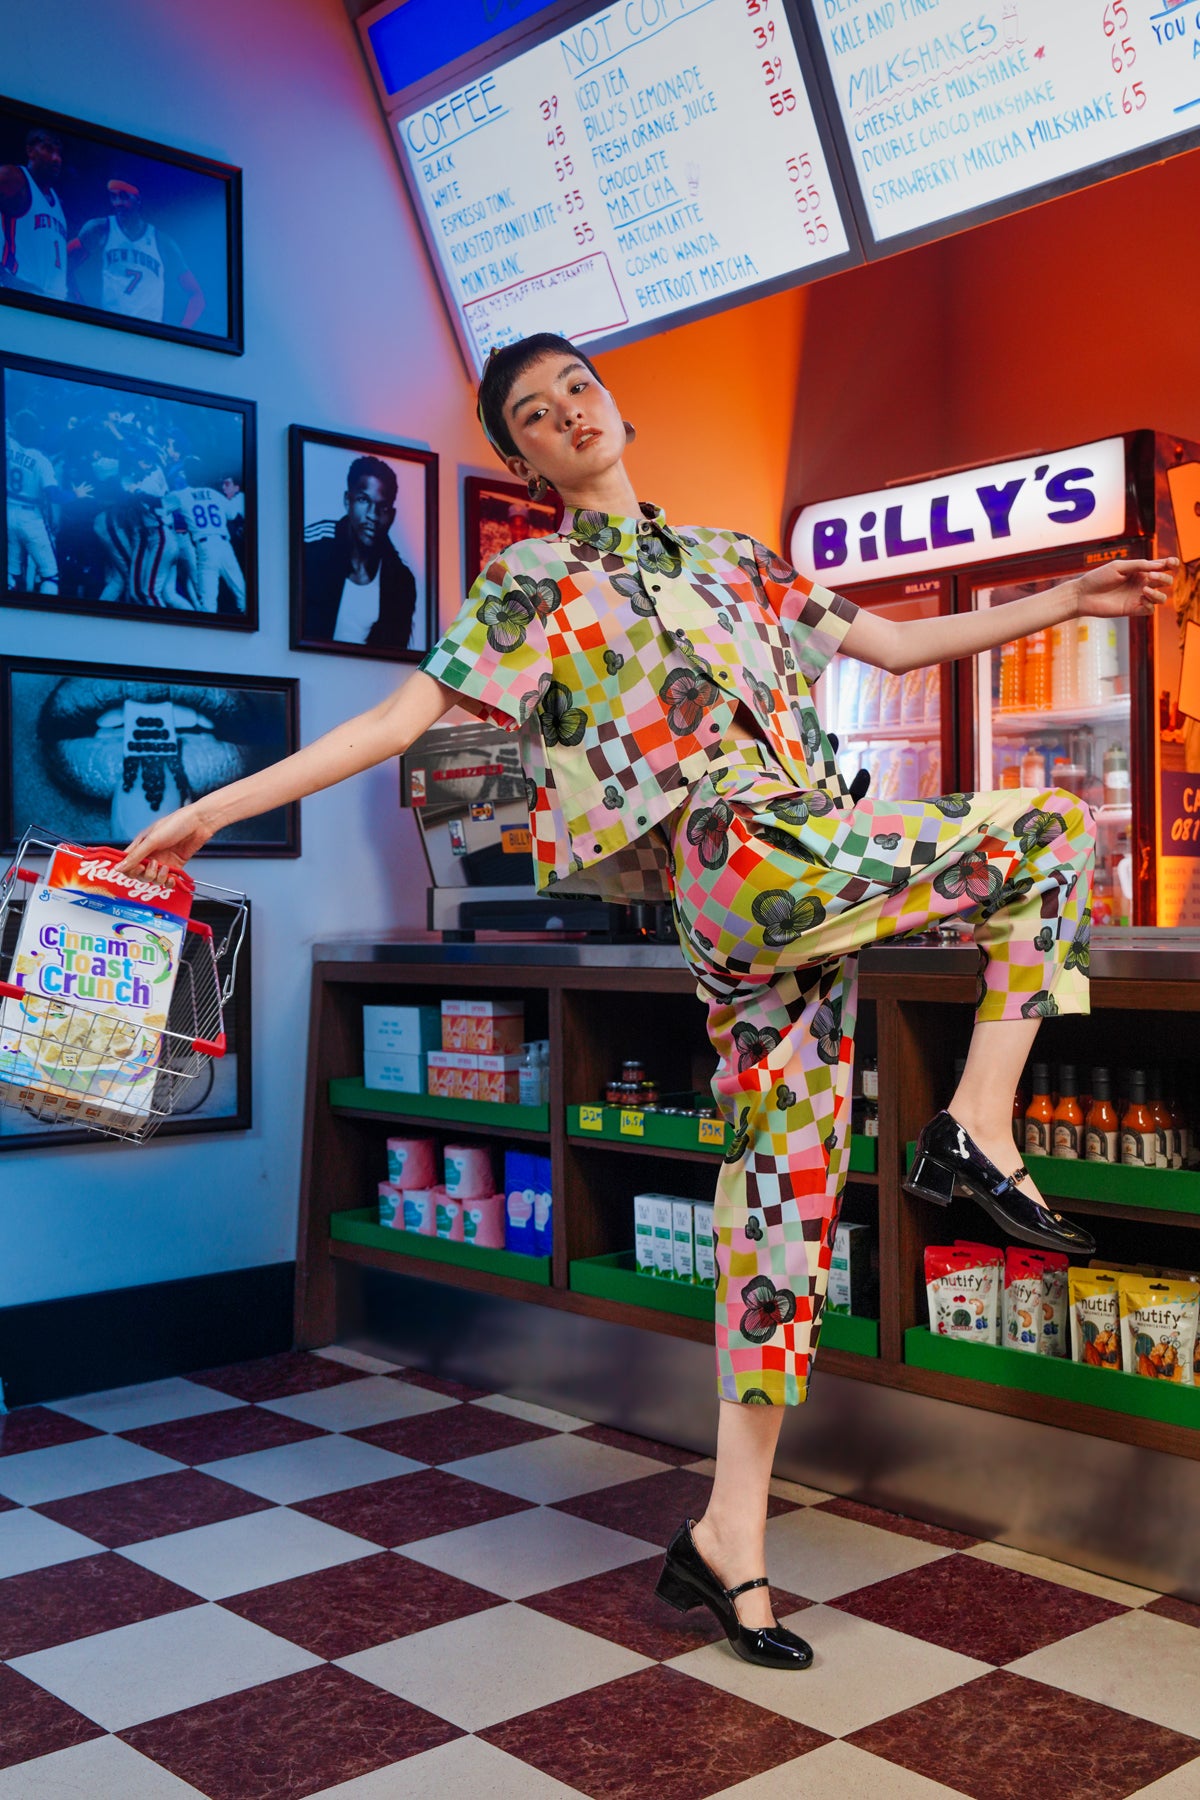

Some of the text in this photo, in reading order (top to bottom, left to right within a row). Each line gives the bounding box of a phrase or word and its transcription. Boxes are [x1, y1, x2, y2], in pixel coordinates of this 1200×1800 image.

[753, 20, 775, 49] 39
[830, 16, 865, 56] KALE
[866, 2, 895, 39] AND
[1102, 0, 1129, 38] 65
[1151, 15, 1186, 46] YOU
[560, 14, 611, 74] NOT
[849, 14, 998, 109] MILKSHAKES
[1111, 37, 1136, 74] 65
[575, 66, 629, 112] ICED TEA
[762, 56, 782, 86] 39
[539, 95, 558, 121] 39
[584, 65, 704, 142] BILLY'S LEMONADE
[769, 88, 796, 116] 55
[854, 48, 1030, 142] CHEESECAKE MILKSHAKE
[407, 76, 502, 153] COFFEE
[592, 91, 717, 168] FRESH ORANGE JUICE
[862, 79, 1055, 172] DOUBLE CHOCO MILKSHAKE
[547, 125, 565, 151] 45
[872, 81, 1147, 209] STRAWBERRY MATCHA MILKSHAKE 65
[422, 154, 455, 183] BLACK
[555, 155, 574, 182] 55
[598, 150, 669, 196] CHOCOLATE
[786, 152, 812, 183] 55
[431, 181, 462, 209] WHITE
[441, 187, 515, 237] ESPRESSO TONIC
[606, 175, 678, 223] MATCHA
[795, 184, 820, 213] 55
[451, 189, 584, 266] ROASTED PEANUT LATTE 55
[573, 221, 595, 245] 55
[617, 202, 704, 253] MATCHA LATTE
[803, 215, 829, 246] 55
[625, 231, 721, 277] COSMO WANDA
[124, 268, 143, 295] 7
[460, 252, 524, 297] MONT BLANC
[635, 253, 759, 308] BEETROOT MATCHA
[192, 504, 222, 529] 86
[44, 925, 155, 962] Cinnamon
[62, 948, 133, 981] Toast
[44, 965, 150, 1006] Crunch
[940, 1274, 983, 1292] nutify
[1081, 1297, 1117, 1313] nutif
[1134, 1309, 1181, 1329] nutify
